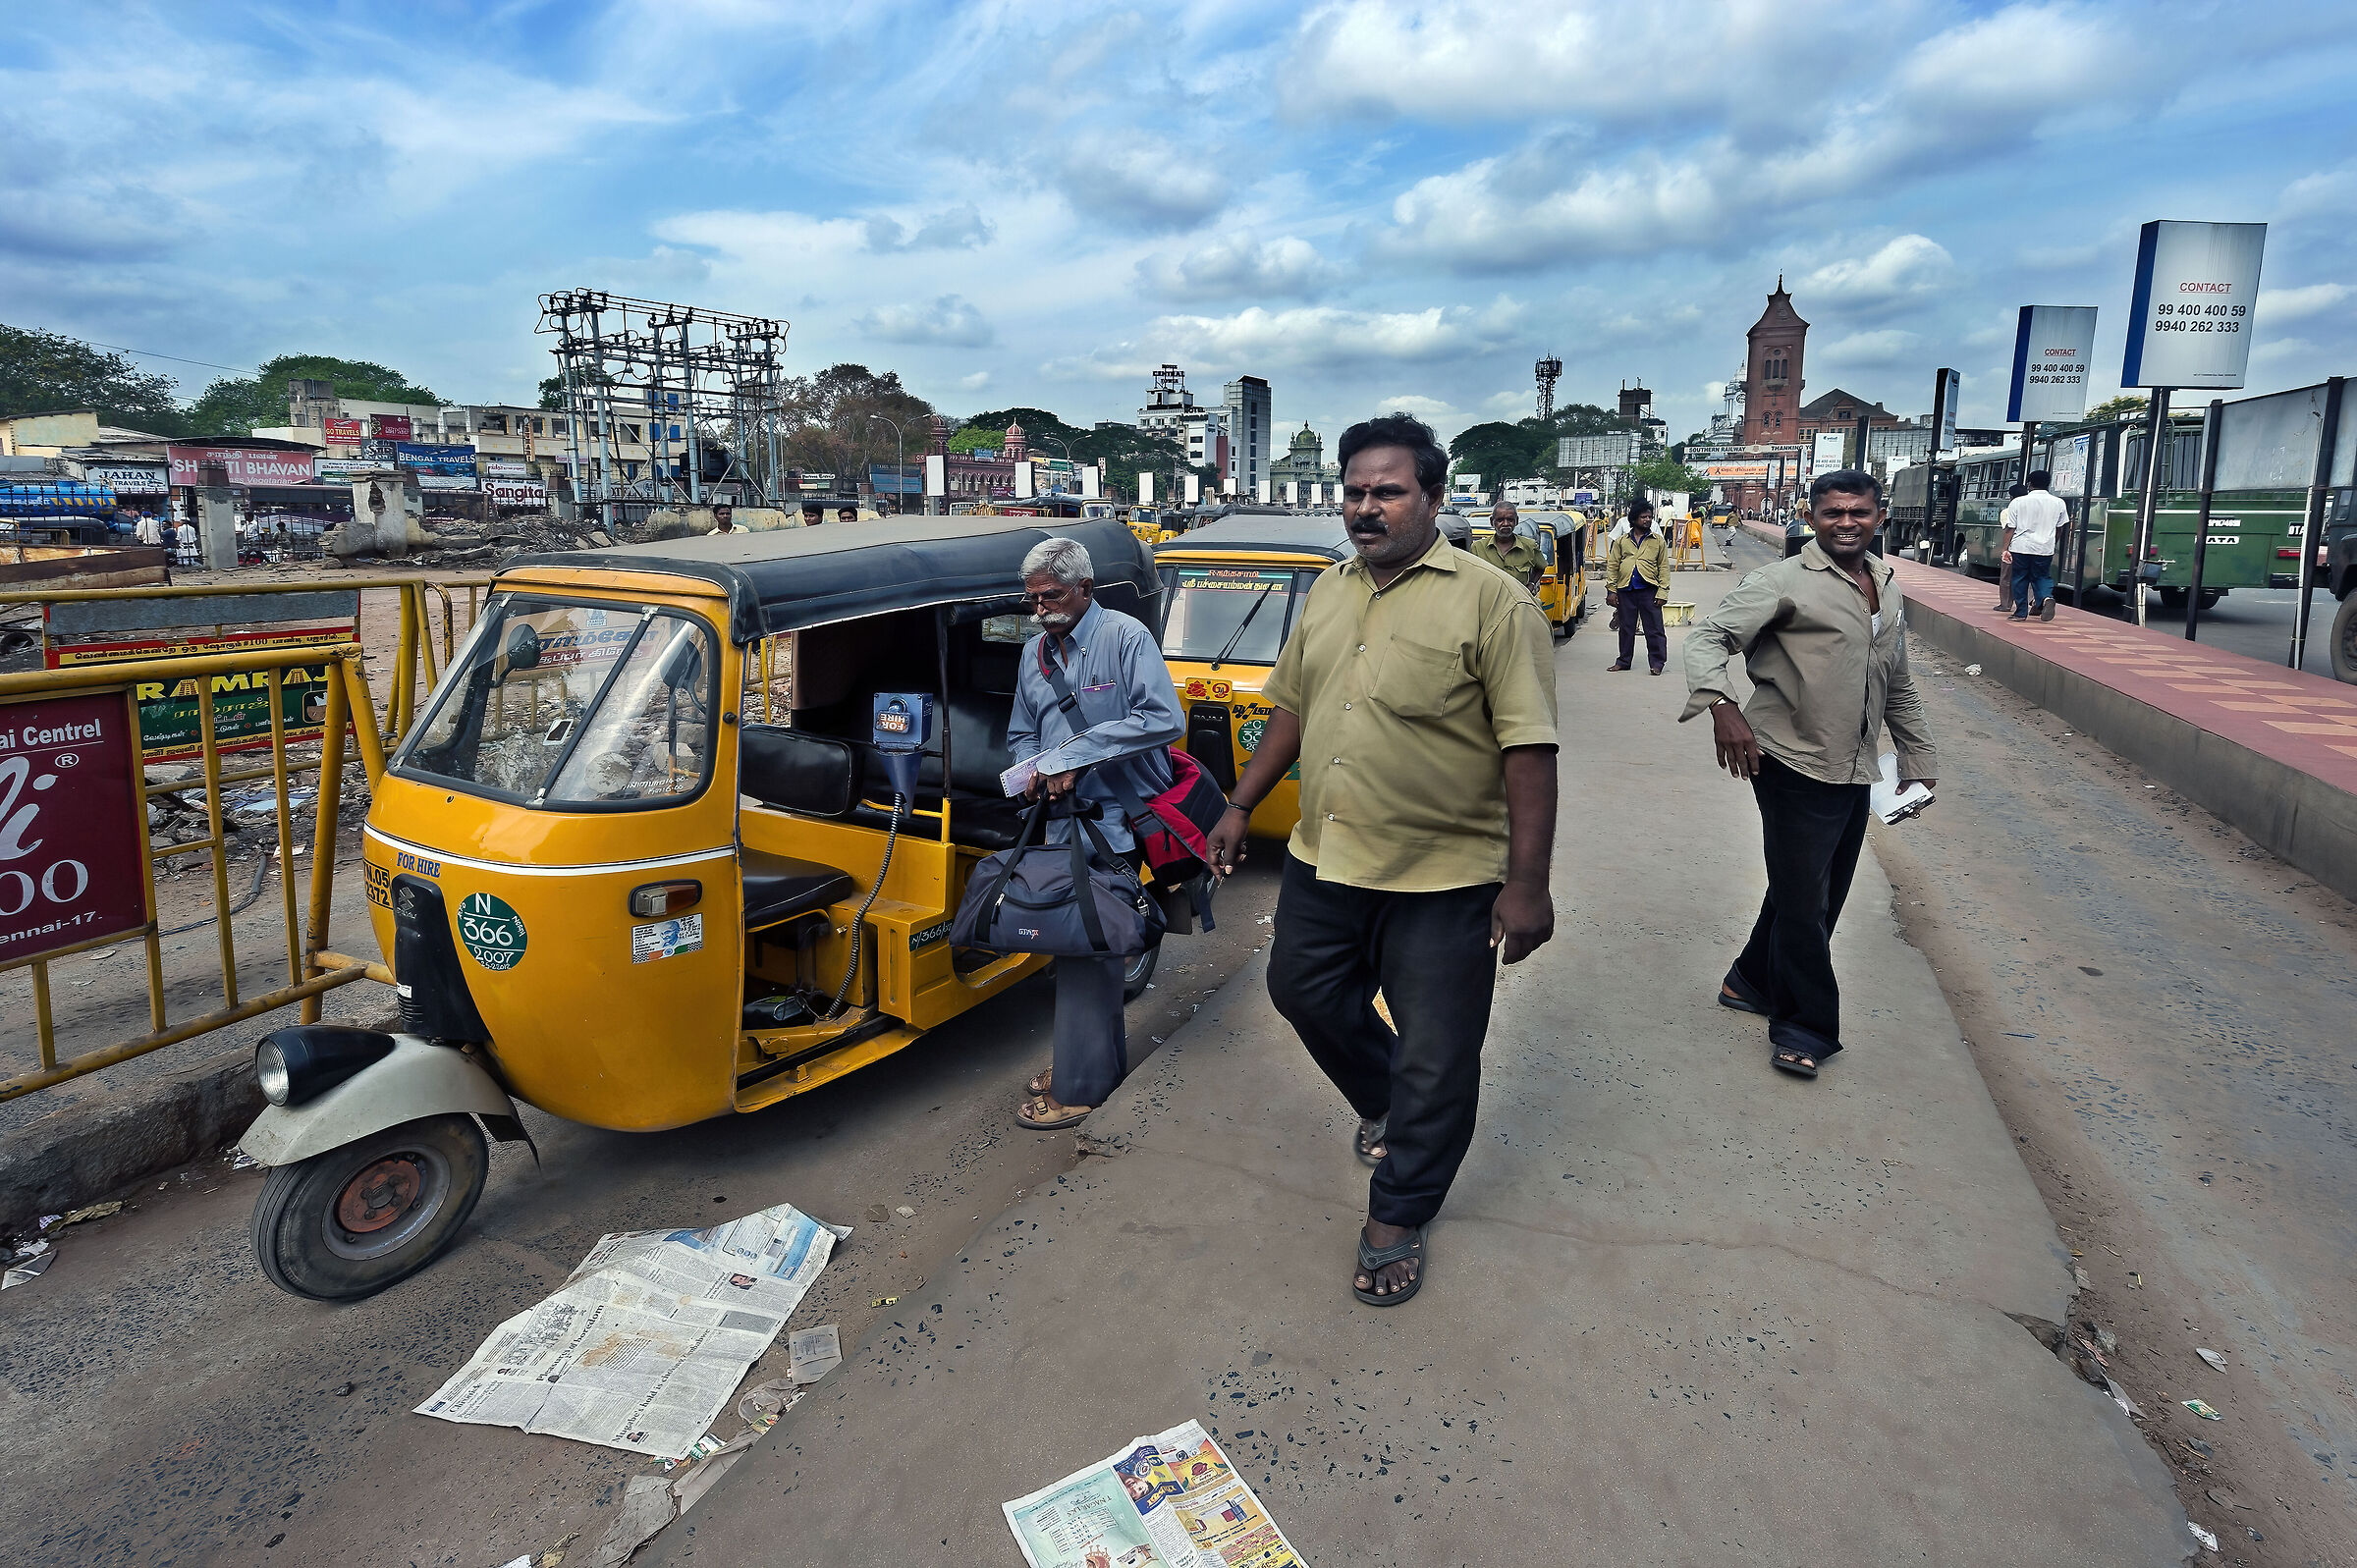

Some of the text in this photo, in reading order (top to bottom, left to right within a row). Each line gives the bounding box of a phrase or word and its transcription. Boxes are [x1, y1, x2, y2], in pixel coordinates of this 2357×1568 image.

[2179, 282, 2232, 293] CONTACT
[2158, 303, 2246, 316] 99 400 400 59
[2155, 320, 2239, 333] 9940 262 333
[2031, 363, 2042, 372] 99
[2043, 363, 2058, 372] 400
[2029, 375, 2050, 384] 9940
[335, 428, 359, 437] TRAVELS
[399, 451, 476, 464] BENGAL TRAVELS
[174, 459, 311, 476] SHTI BHAVAN
[99, 470, 156, 481] JAHAN
[113, 479, 146, 488] TRAVELS
[485, 482, 545, 503] Sangita
[880, 713, 905, 724] HIRE
[23, 718, 102, 747] Centrel
[881, 721, 904, 731] FOR
[396, 851, 441, 879] FOR HIRE
[474, 892, 491, 916] N
[463, 916, 514, 946] 366
[473, 946, 515, 964] 2007
[573, 1303, 605, 1349] boredom
[611, 1408, 644, 1443] Mugabe's
[639, 1389, 658, 1408] hold
